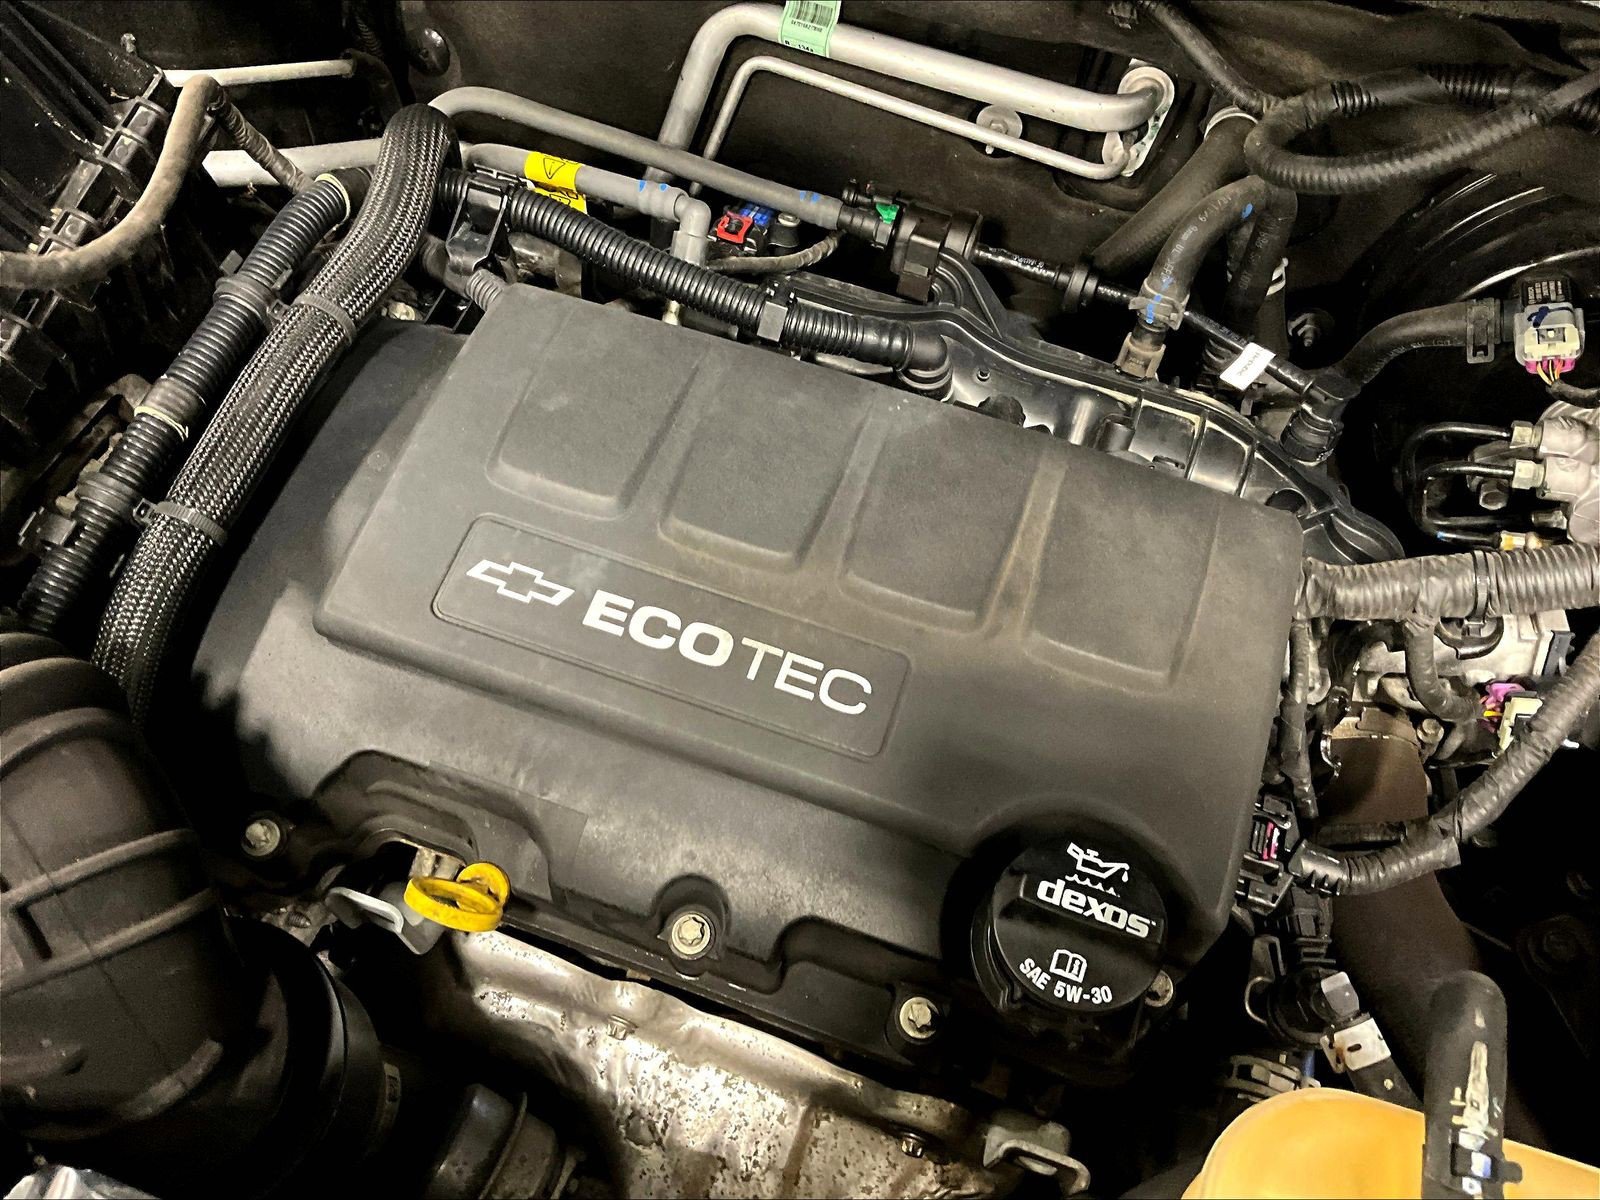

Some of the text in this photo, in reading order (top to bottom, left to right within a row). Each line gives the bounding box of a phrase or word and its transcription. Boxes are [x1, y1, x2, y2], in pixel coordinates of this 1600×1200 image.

[1170, 243, 1185, 255] UL
[582, 589, 872, 715] ECOTEC
[1036, 878, 1151, 938] dexos
[1019, 958, 1113, 1005] SAE 5W-30
